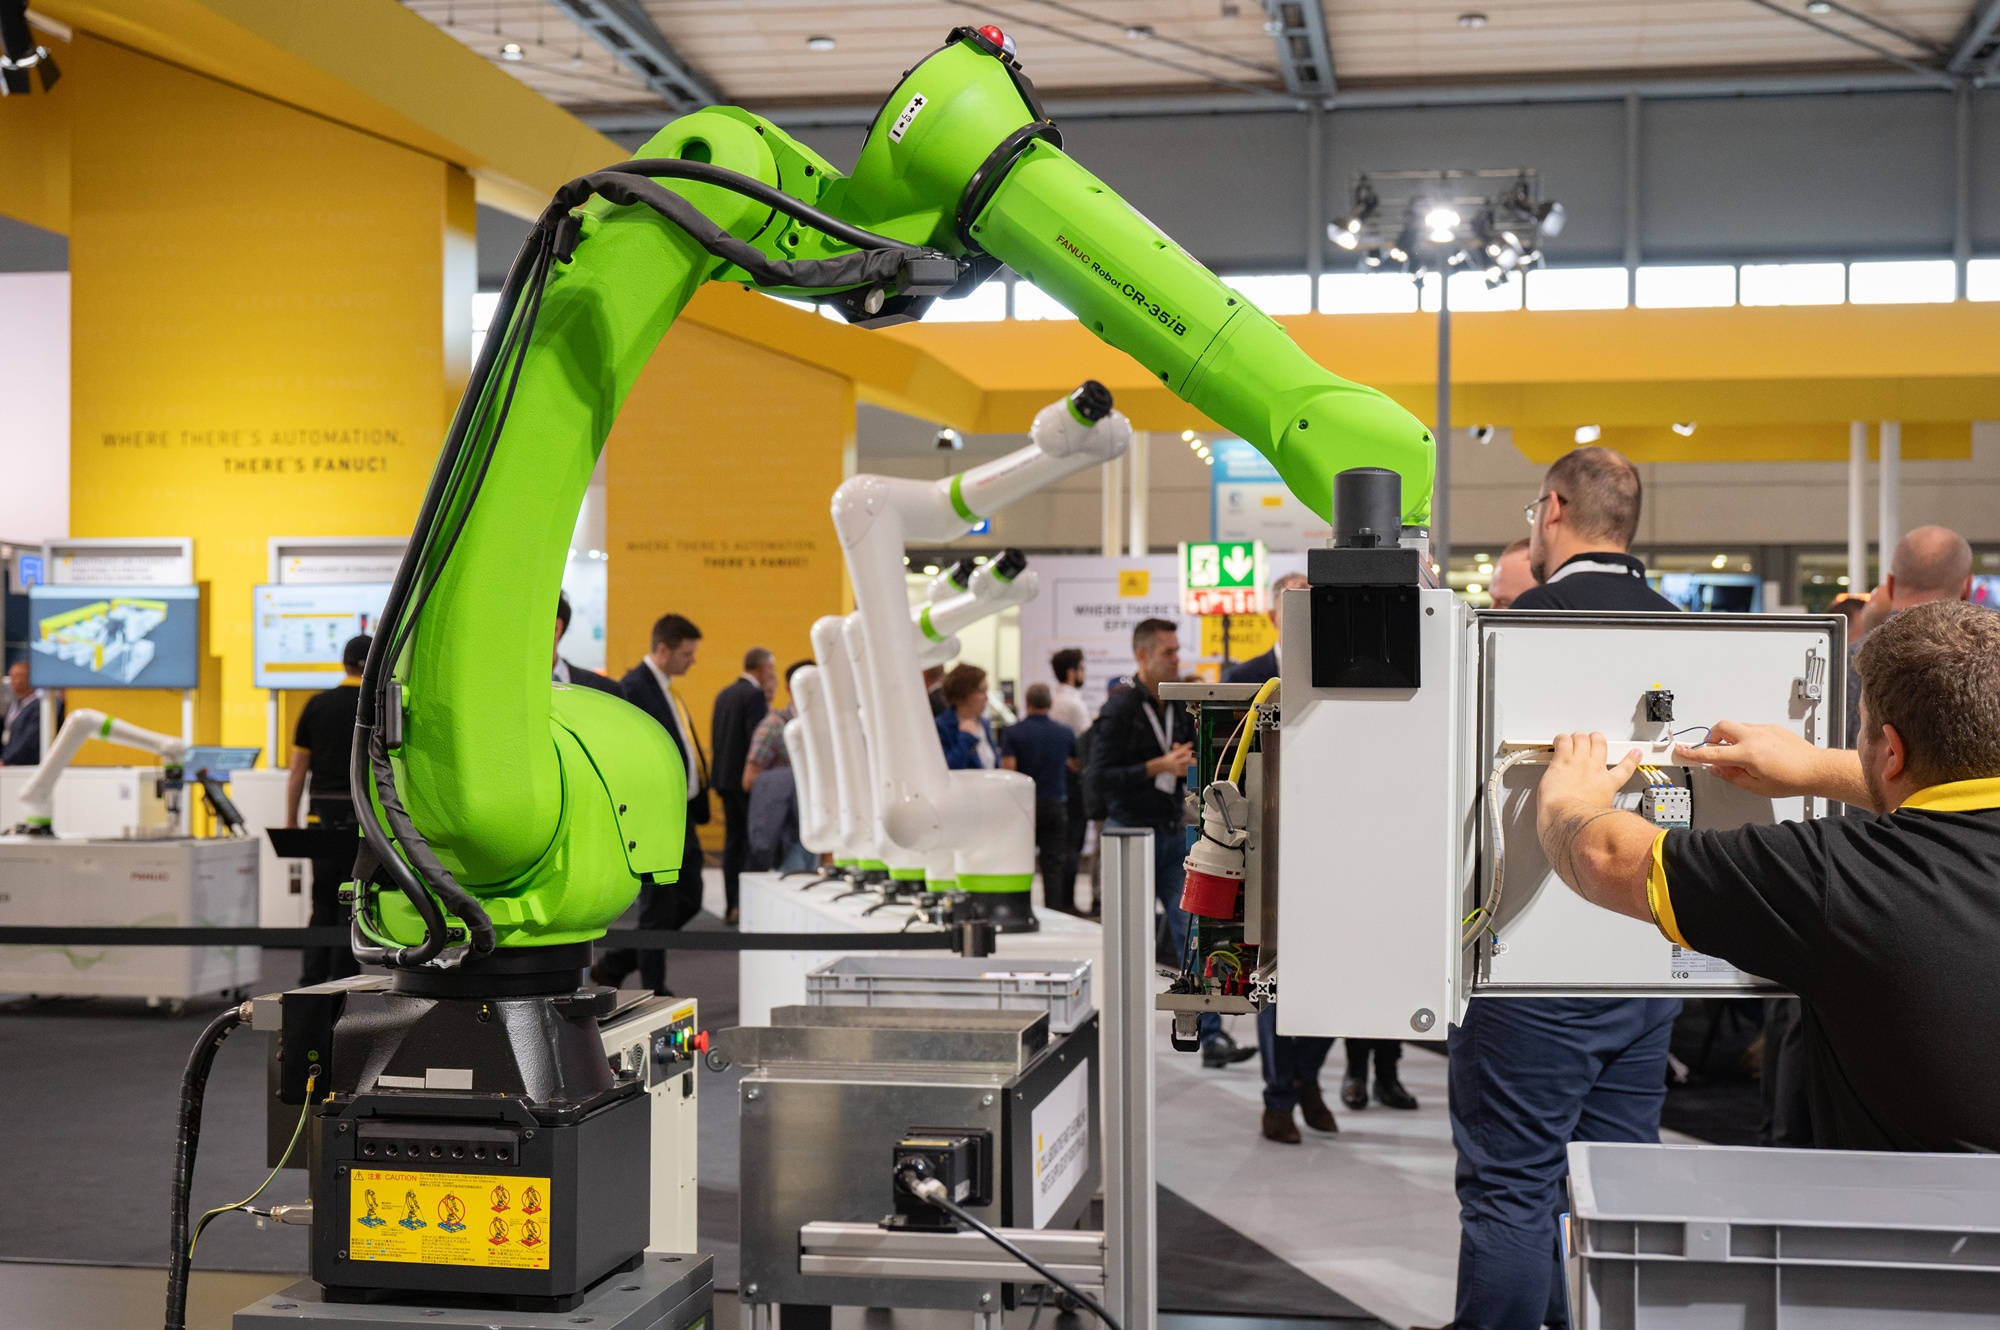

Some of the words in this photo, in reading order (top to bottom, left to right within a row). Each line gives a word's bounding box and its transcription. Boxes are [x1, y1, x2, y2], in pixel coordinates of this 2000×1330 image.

[902, 114, 912, 122] J3
[1056, 235, 1090, 264] FANUC
[1091, 262, 1121, 288] Robot
[1122, 284, 1186, 336] CR-35iB
[101, 430, 168, 448] WHERE
[181, 430, 262, 447] THERE'S
[270, 429, 406, 448] AUTOMATION,
[224, 457, 304, 474] THERE'S
[313, 456, 387, 472] FANUC!
[627, 541, 668, 550] WHERE
[704, 556, 756, 568] THERE'S
[1074, 604, 1120, 615] WHERE
[1212, 617, 1267, 628] TERE'S
